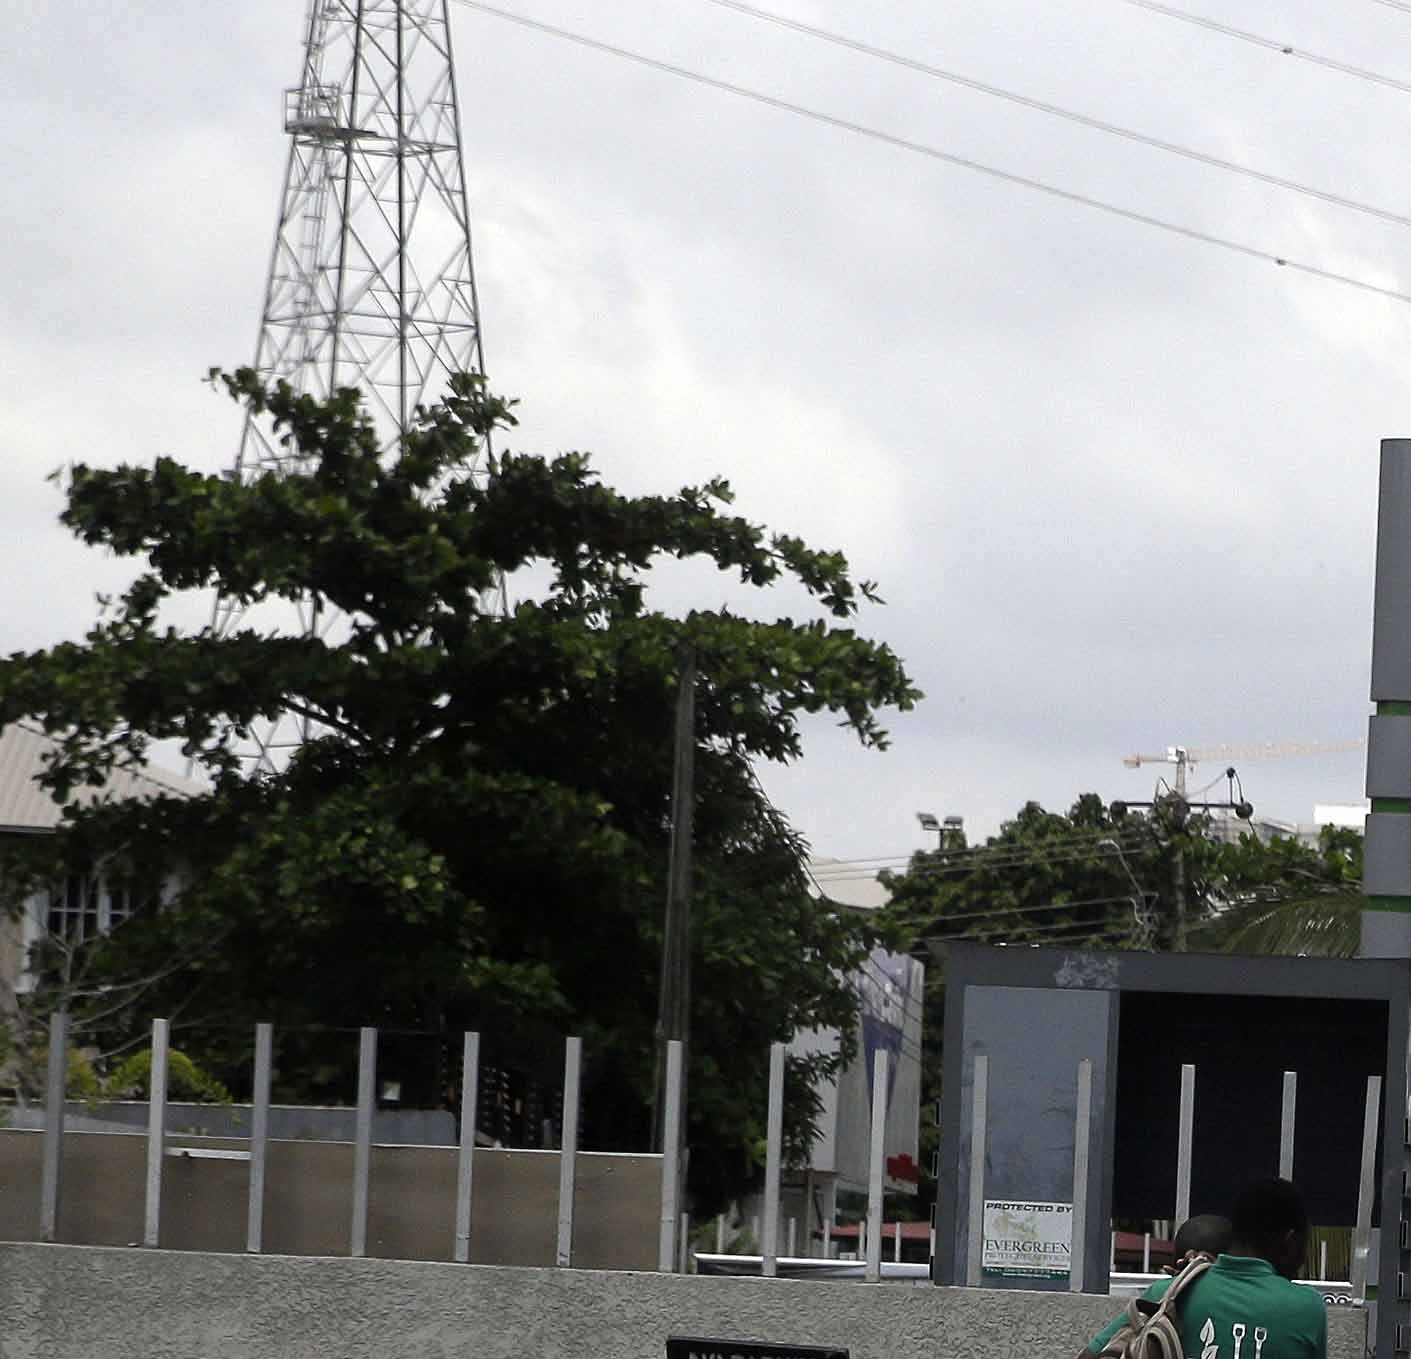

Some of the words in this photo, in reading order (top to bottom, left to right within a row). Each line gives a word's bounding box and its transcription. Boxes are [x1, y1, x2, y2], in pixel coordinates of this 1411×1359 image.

[986, 1203, 1054, 1213] PROTECTED
[1056, 1205, 1072, 1214] BY
[986, 1239, 1071, 1254] EVERGREEN
